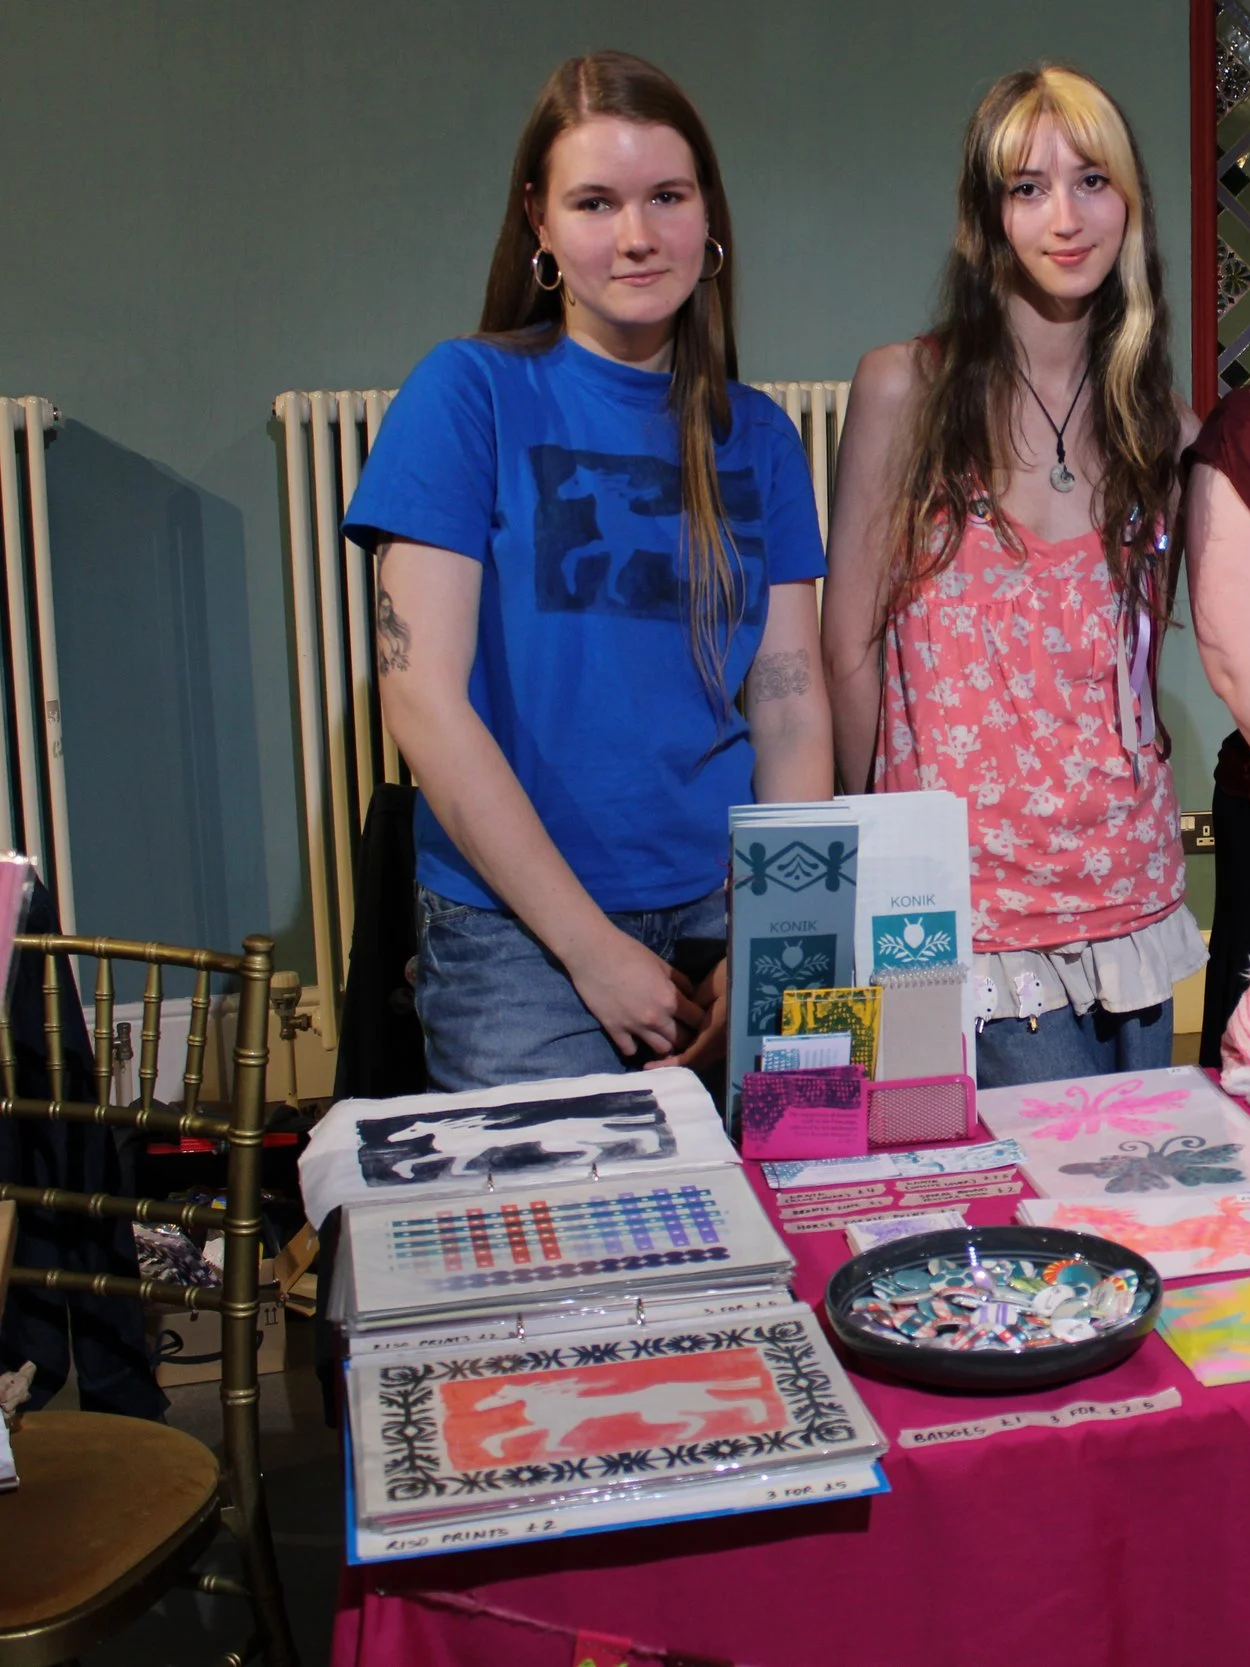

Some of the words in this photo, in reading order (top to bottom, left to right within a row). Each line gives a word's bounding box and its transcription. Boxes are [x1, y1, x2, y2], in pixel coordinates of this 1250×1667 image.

[891, 894, 936, 909] KONIK
[769, 920, 818, 933] KONIK
[418, 1335, 471, 1347] PRINTS
[914, 1426, 988, 1443] BADGES
[1050, 1415, 1061, 1425] 3
[1070, 1405, 1099, 1419] FOR
[767, 1490, 777, 1501] 3
[784, 1485, 816, 1497] FOR
[385, 1537, 429, 1551] RISO
[441, 1527, 509, 1544] PRINTS
[526, 1520, 558, 1534] £2
